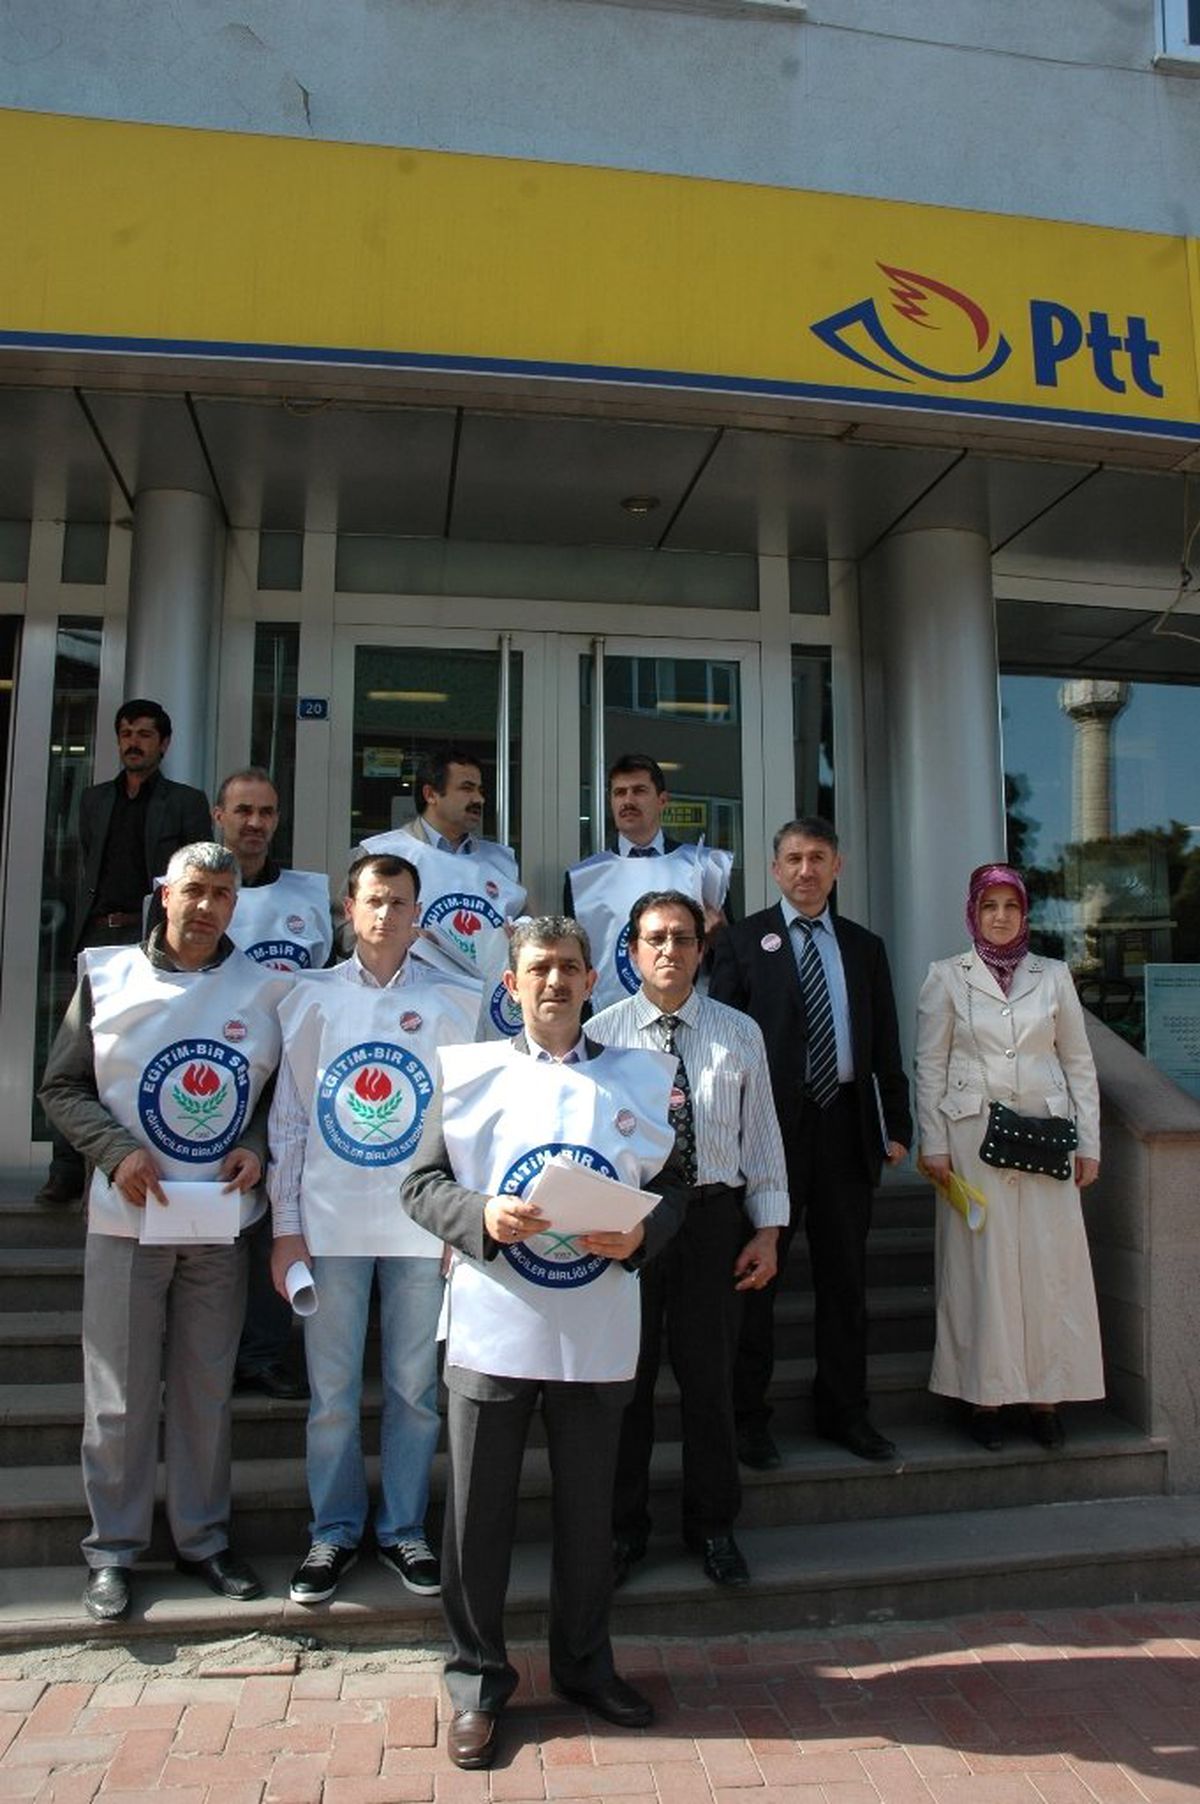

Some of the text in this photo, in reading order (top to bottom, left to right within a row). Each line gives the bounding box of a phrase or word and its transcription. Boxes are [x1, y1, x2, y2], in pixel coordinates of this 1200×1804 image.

[1030, 299, 1164, 398] Ptt
[305, 703, 322, 715] 20
[405, 1060, 432, 1095] SEN
